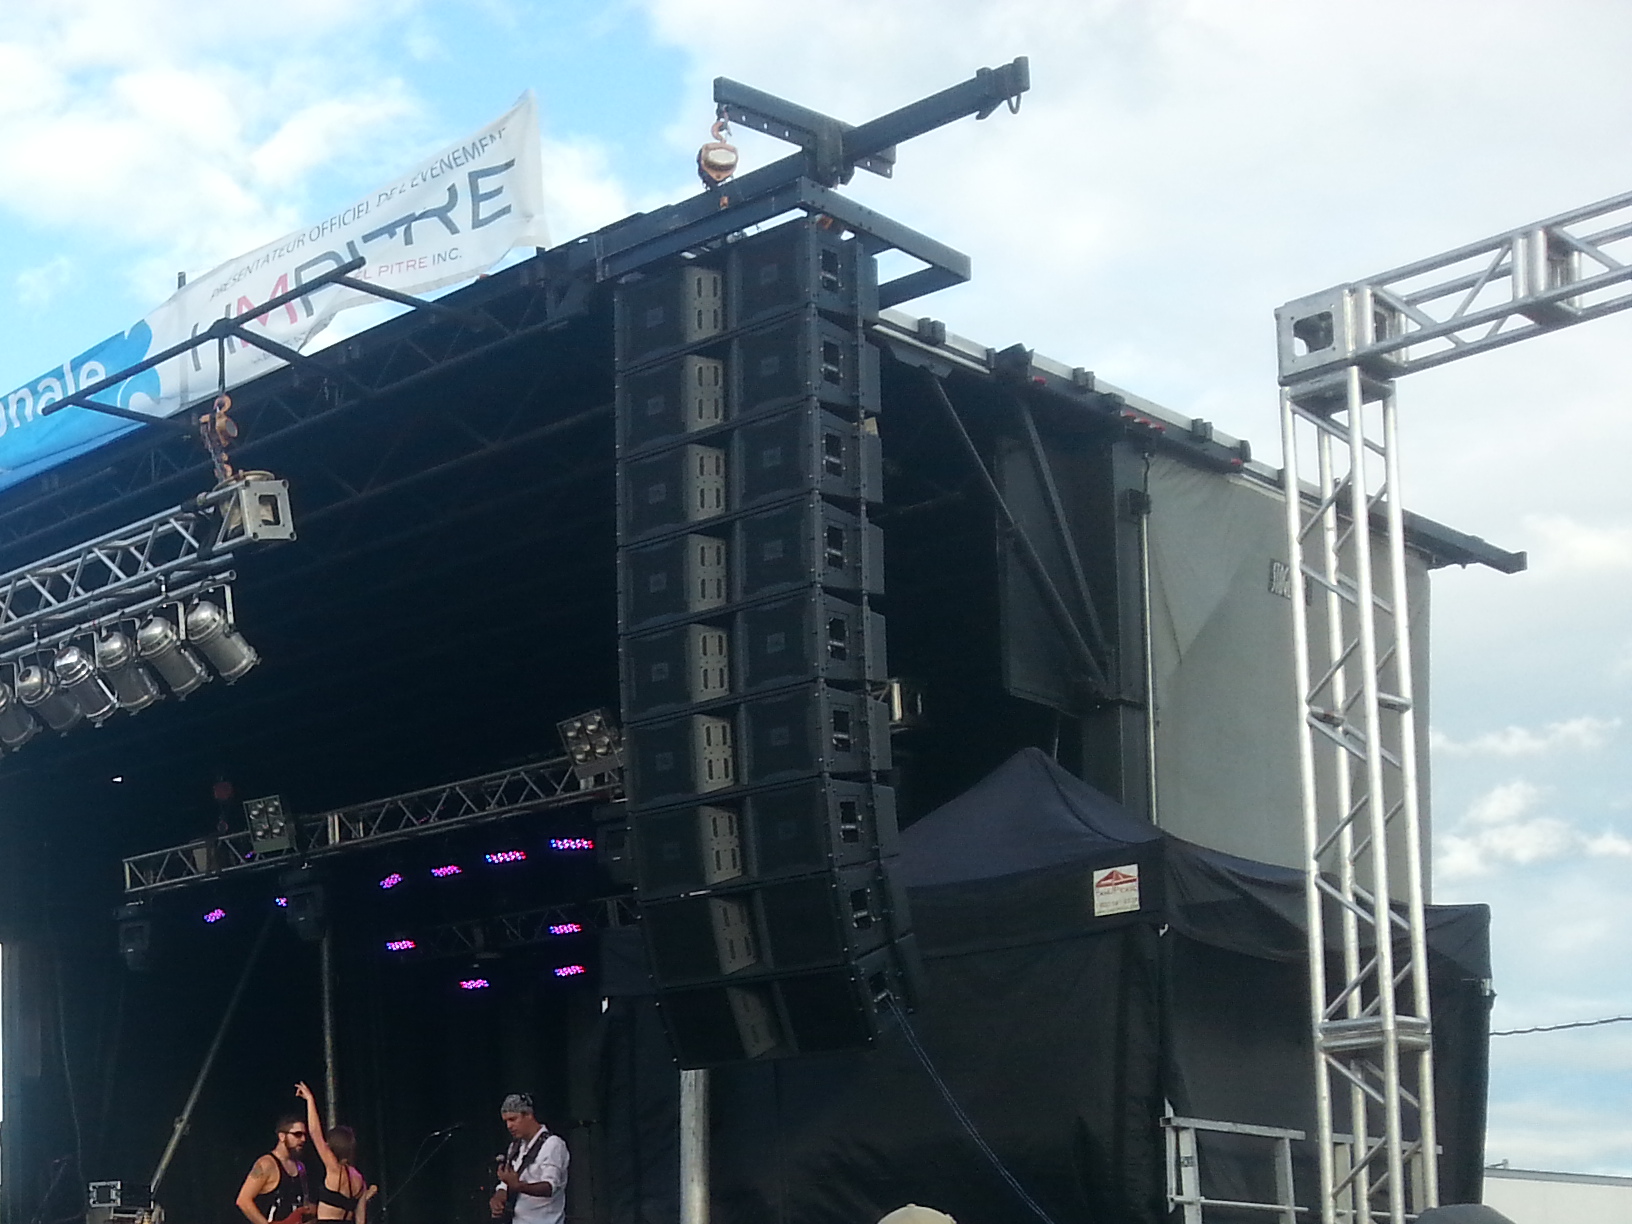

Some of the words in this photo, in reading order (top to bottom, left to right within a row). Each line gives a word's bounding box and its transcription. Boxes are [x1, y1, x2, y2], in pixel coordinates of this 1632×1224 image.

[309, 200, 371, 242] OFFICIEL
[378, 256, 428, 277] PITRE
[432, 247, 462, 266] INC.
